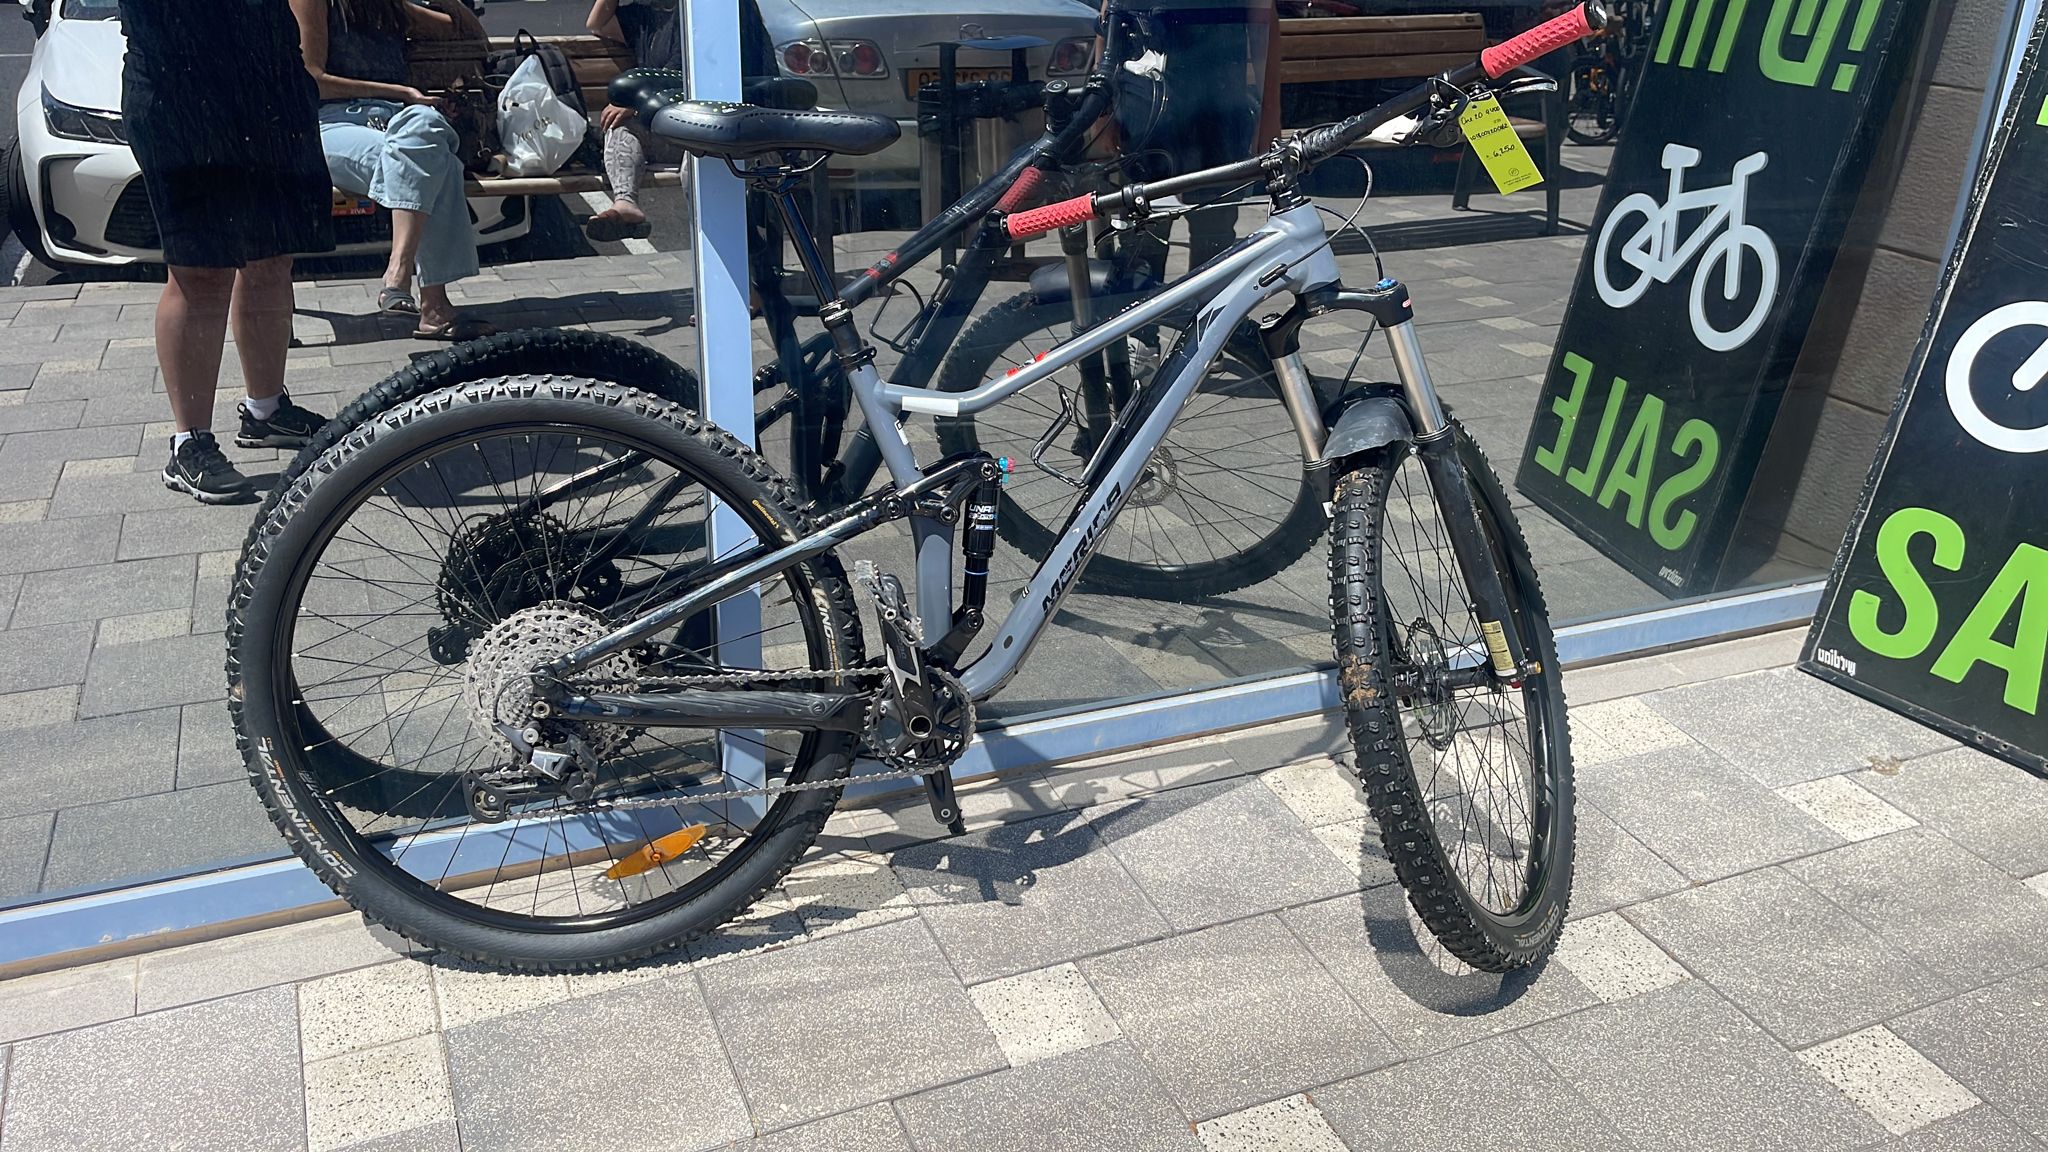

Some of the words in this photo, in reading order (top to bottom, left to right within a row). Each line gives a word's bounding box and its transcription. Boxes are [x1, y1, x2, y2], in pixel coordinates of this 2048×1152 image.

[812, 587, 834, 640] KING
[1042, 481, 1123, 616] MERIDA
[258, 736, 353, 879] CONTINENTAL
